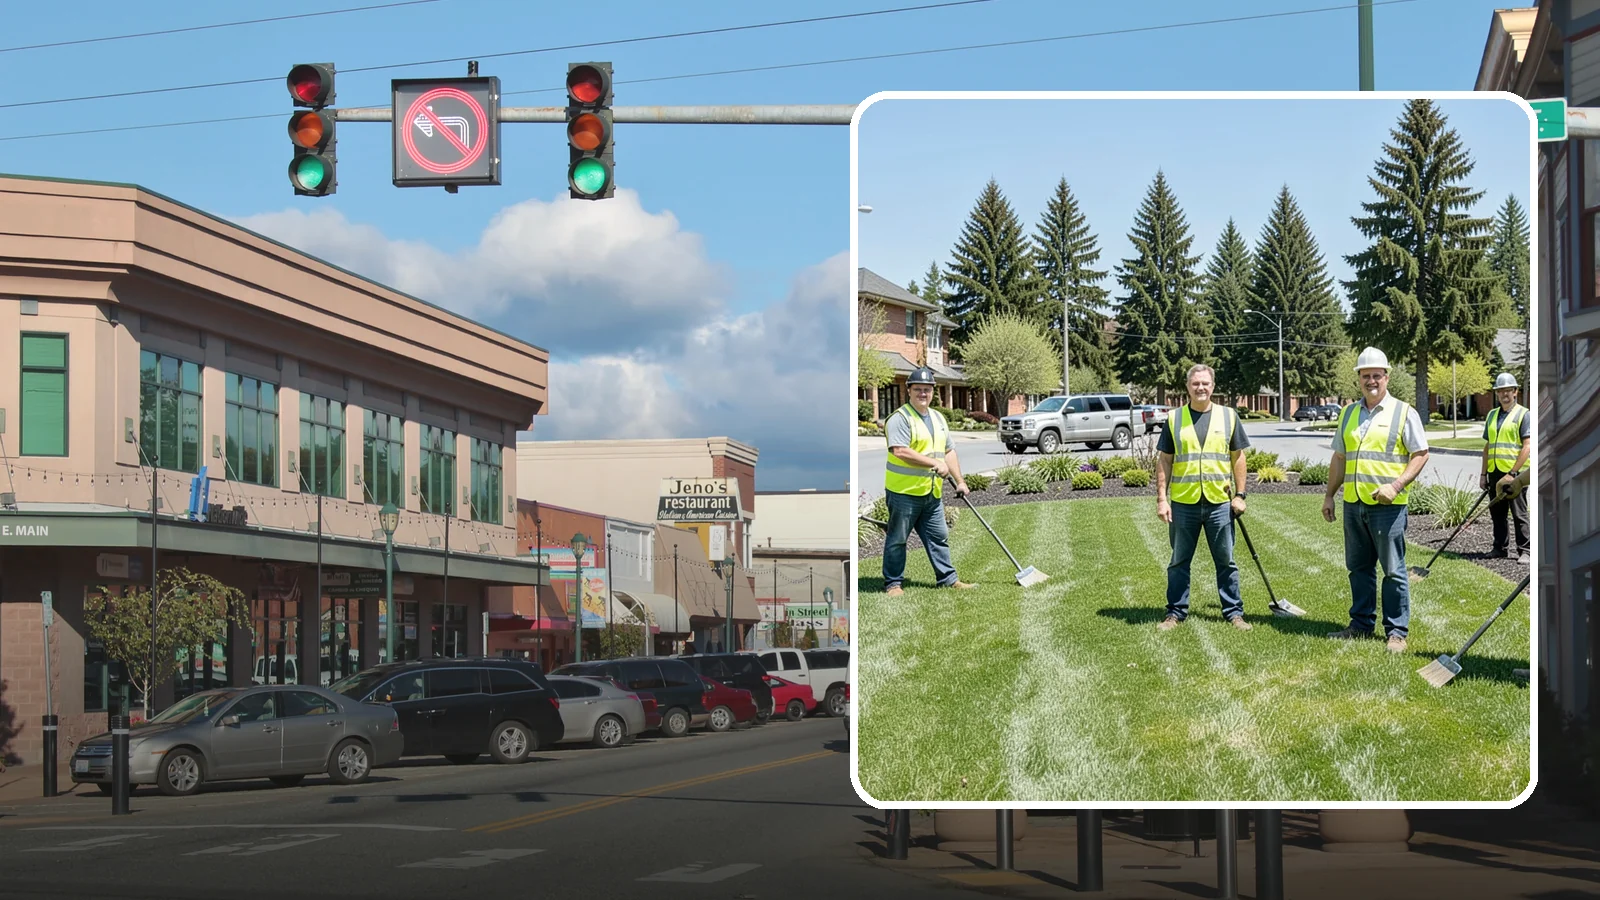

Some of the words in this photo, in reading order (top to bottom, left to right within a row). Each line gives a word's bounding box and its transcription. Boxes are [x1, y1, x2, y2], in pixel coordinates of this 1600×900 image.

[670, 480, 728, 494] Jeno's
[665, 496, 731, 509] restaurant
[659, 510, 681, 519] Italian
[686, 510, 714, 519] American
[715, 510, 737, 519] Cuisine
[2, 525, 13, 536] E.
[15, 525, 49, 536] MAIN
[797, 608, 828, 617] Street
